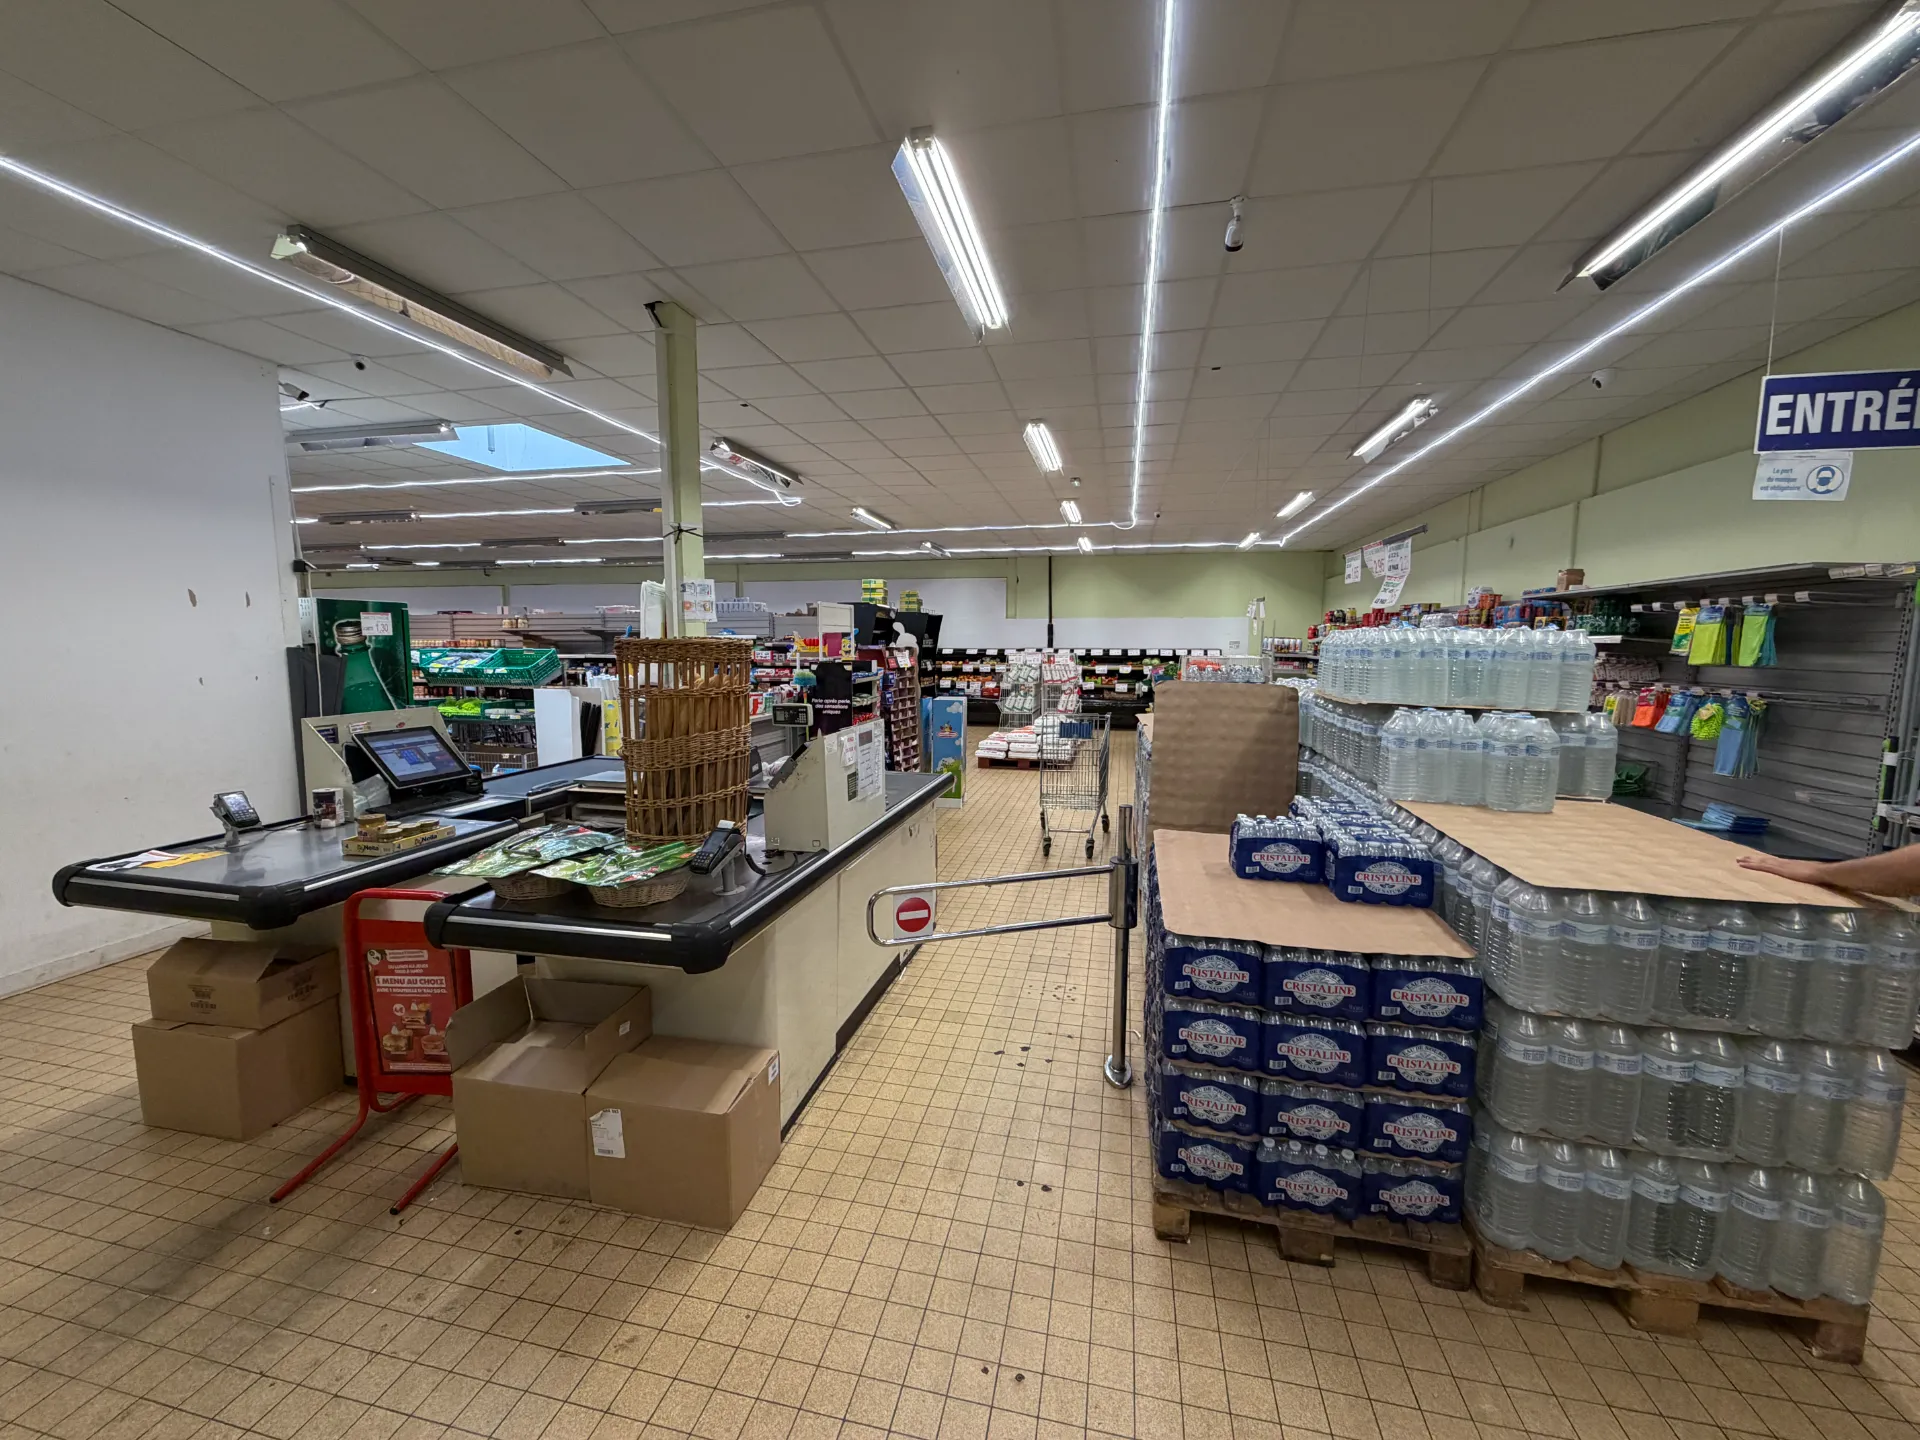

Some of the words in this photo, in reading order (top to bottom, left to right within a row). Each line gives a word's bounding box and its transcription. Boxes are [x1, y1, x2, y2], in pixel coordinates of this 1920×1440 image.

[1254, 853, 1310, 863] CRISTALINE
[1357, 873, 1420, 883] CRISTALINE
[1184, 965, 1248, 981] CRISTALINE
[1285, 981, 1354, 995] CRISTALINE
[1393, 991, 1468, 1005] CRISTALINE
[1180, 1029, 1244, 1046] CRISTALINE
[1279, 1045, 1349, 1061] CRISTALINE
[1389, 1056, 1459, 1072] CRISTALINE
[1181, 1094, 1245, 1114] CRISTALINE
[1280, 1114, 1349, 1131] CRISTALINE
[1385, 1124, 1456, 1140] CRISTALINE
[1179, 1150, 1242, 1173] CRISTALINE
[1278, 1180, 1347, 1198] CRISTALINE
[1381, 1192, 1449, 1206] CRISTALINE
